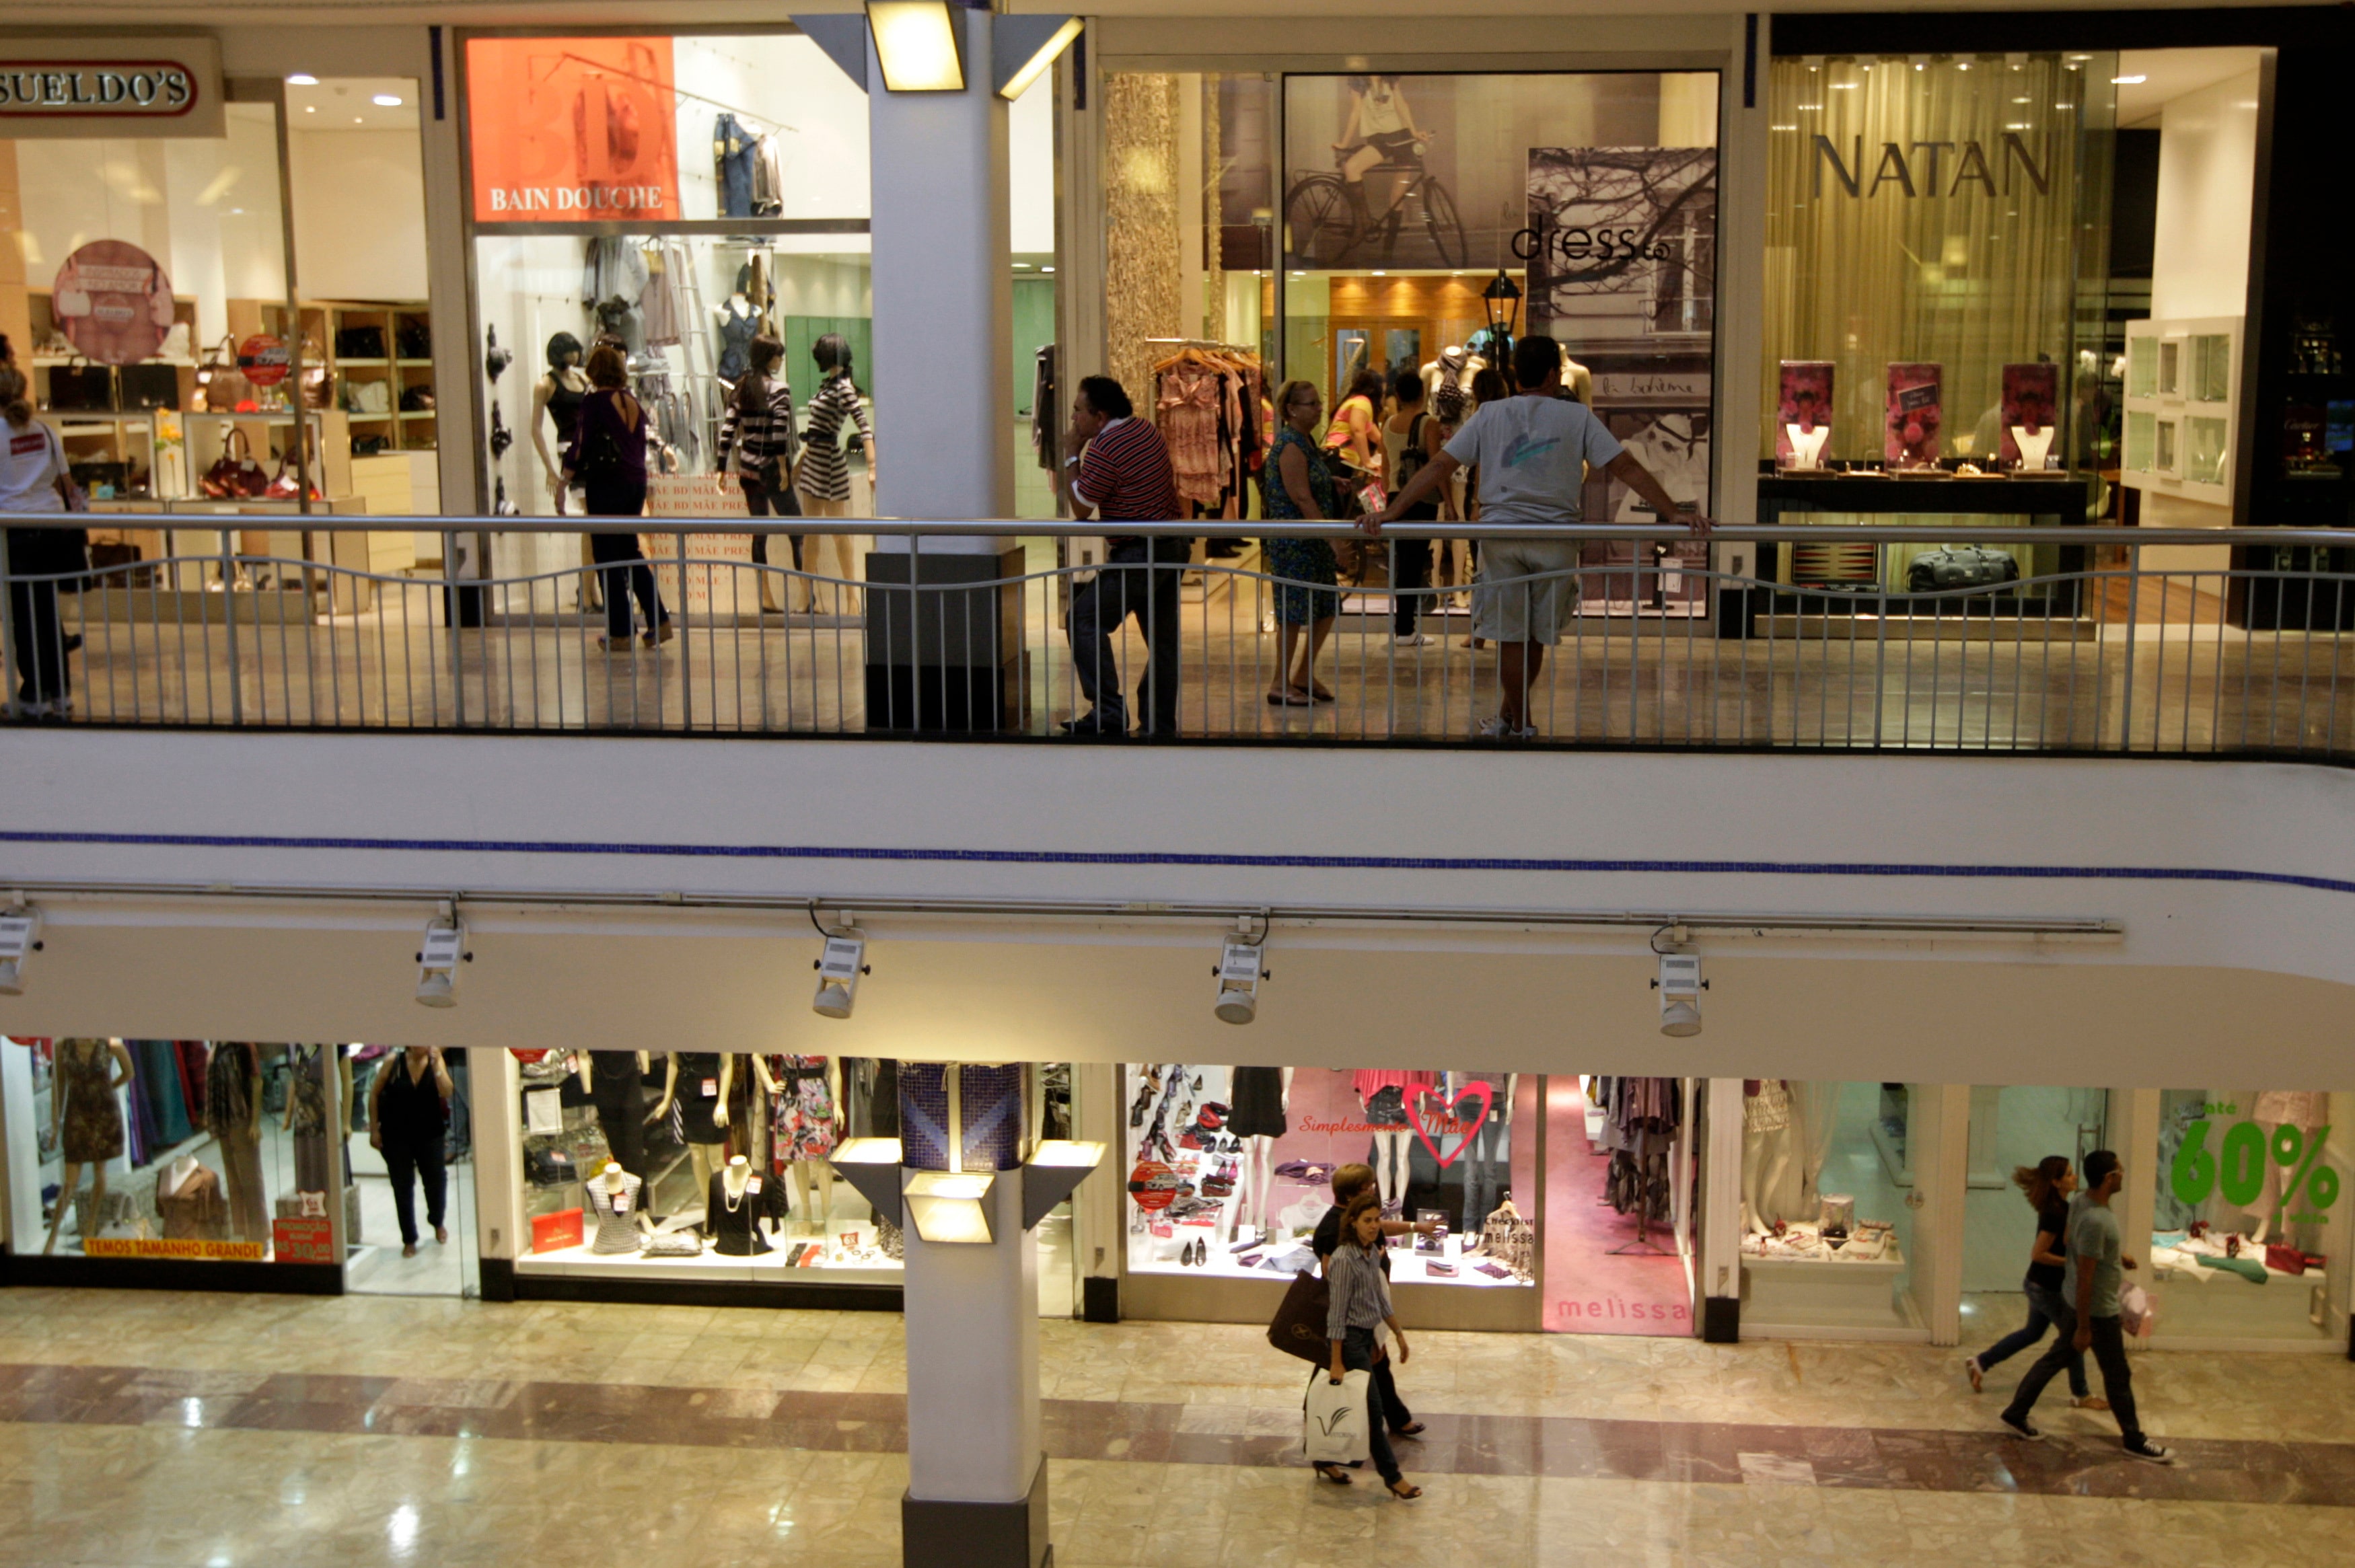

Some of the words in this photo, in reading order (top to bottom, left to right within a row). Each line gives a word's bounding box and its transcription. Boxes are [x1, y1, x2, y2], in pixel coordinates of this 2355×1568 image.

[1811, 133, 2051, 198] NATAN
[491, 187, 550, 211] BAIN
[556, 186, 663, 210] DOUCHE
[693, 499, 717, 511] MÃE
[695, 544, 719, 556] MÃE
[1299, 1115, 1407, 1137] Simplesmente
[2171, 1121, 2340, 1209] 60%
[89, 1240, 132, 1255] TEMOS
[136, 1242, 201, 1257] TAMANHO
[206, 1242, 258, 1258] GRANDE
[1484, 1232, 1533, 1244] melissa
[1558, 1298, 1688, 1320] melissa
